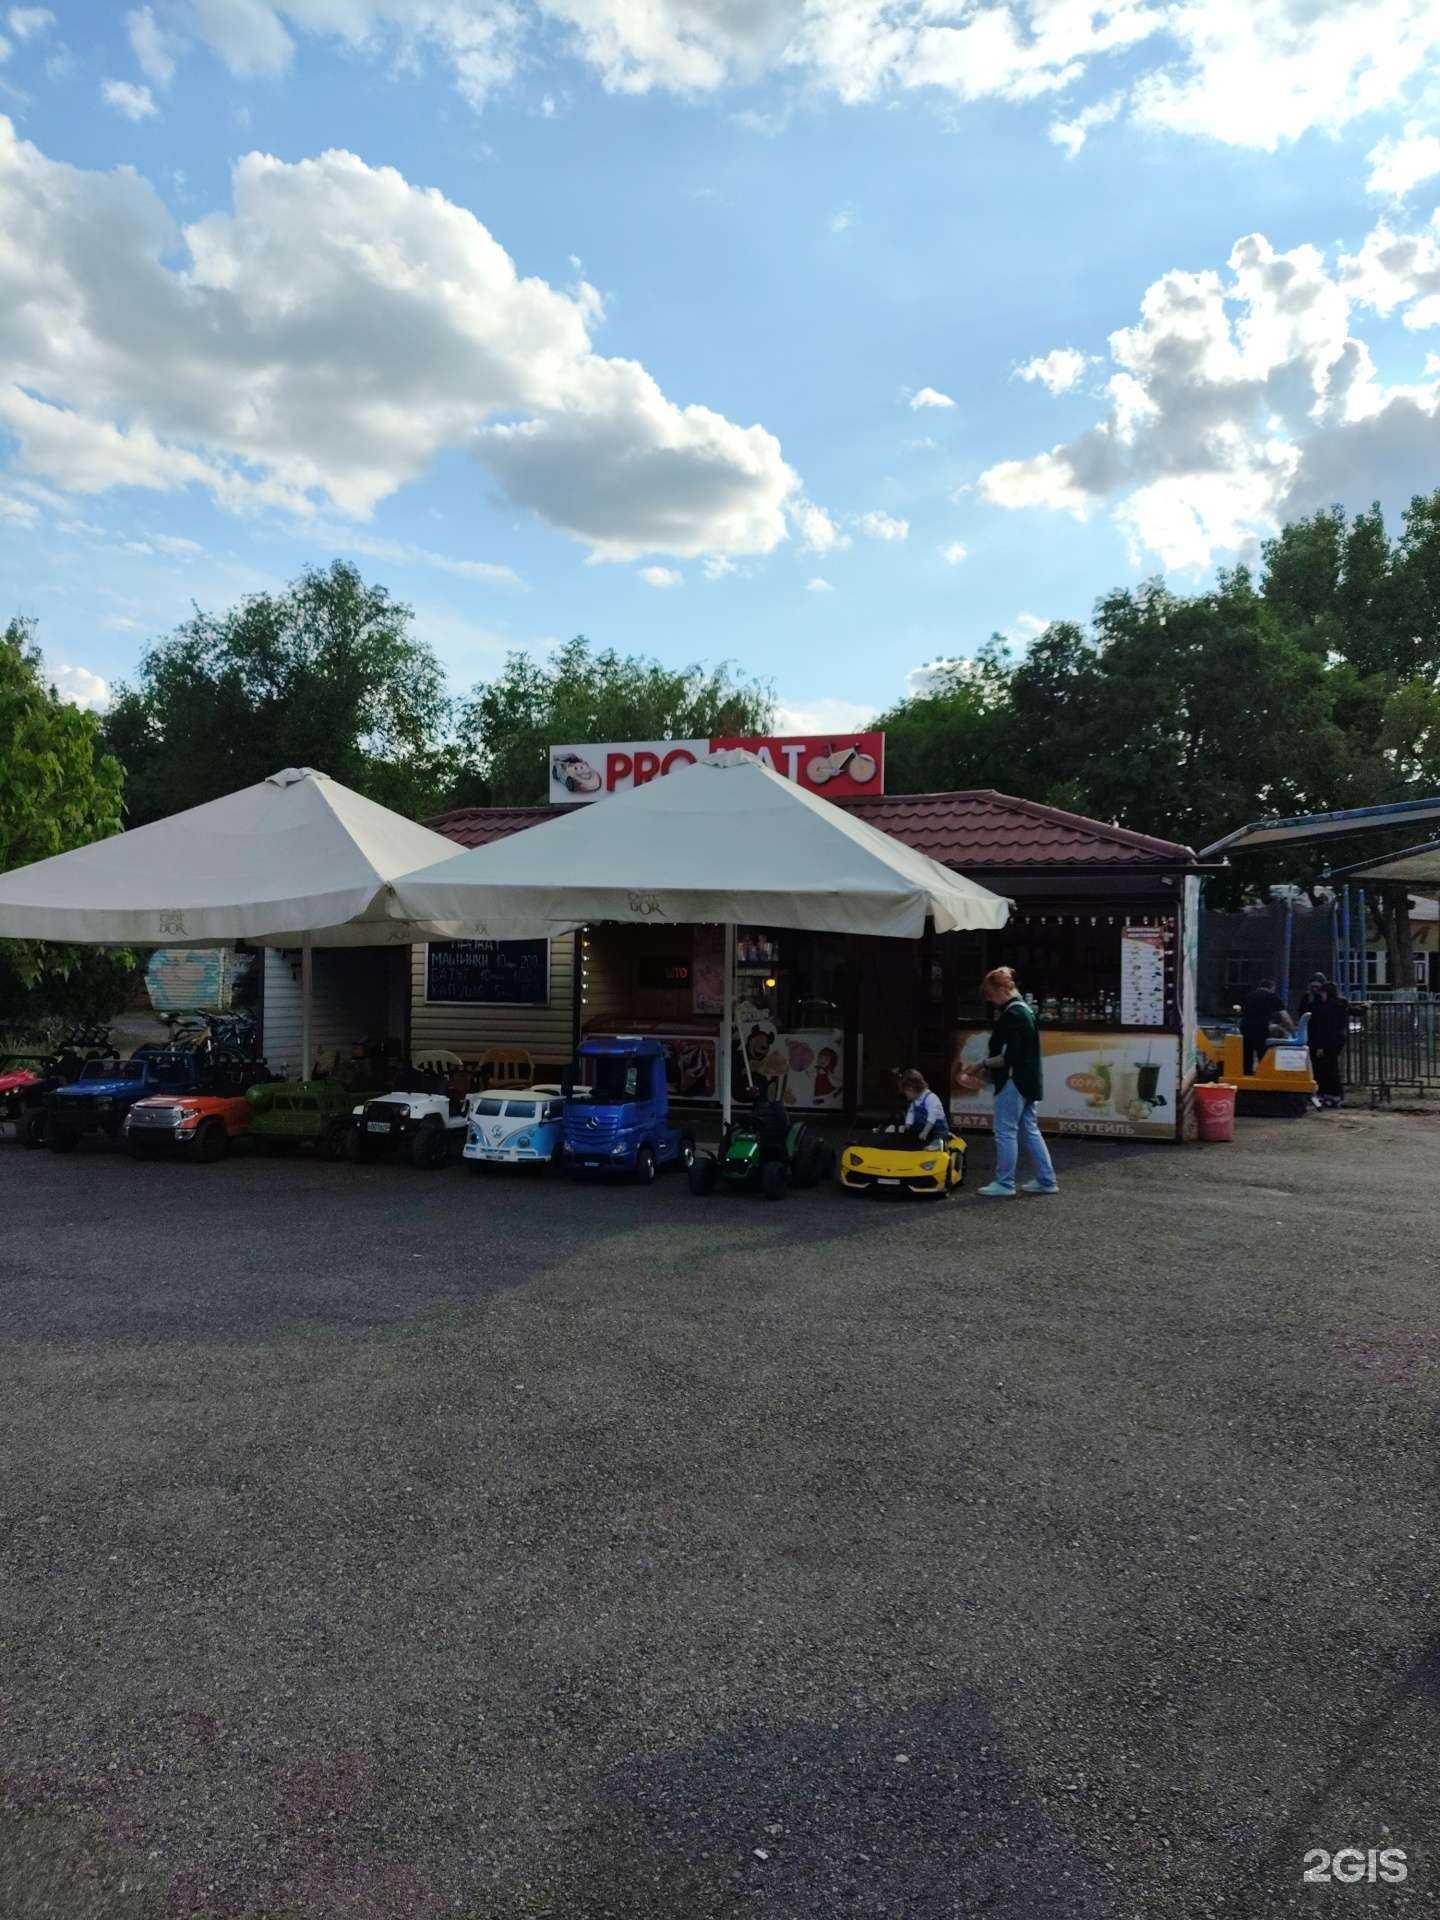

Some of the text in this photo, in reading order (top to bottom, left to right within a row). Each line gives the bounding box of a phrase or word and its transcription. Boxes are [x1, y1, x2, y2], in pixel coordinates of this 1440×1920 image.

[606, 744, 806, 792] PROAT
[952, 1115, 989, 1127] ВАТА
[1057, 1120, 1136, 1135] КОКТЕЙЛЬ
